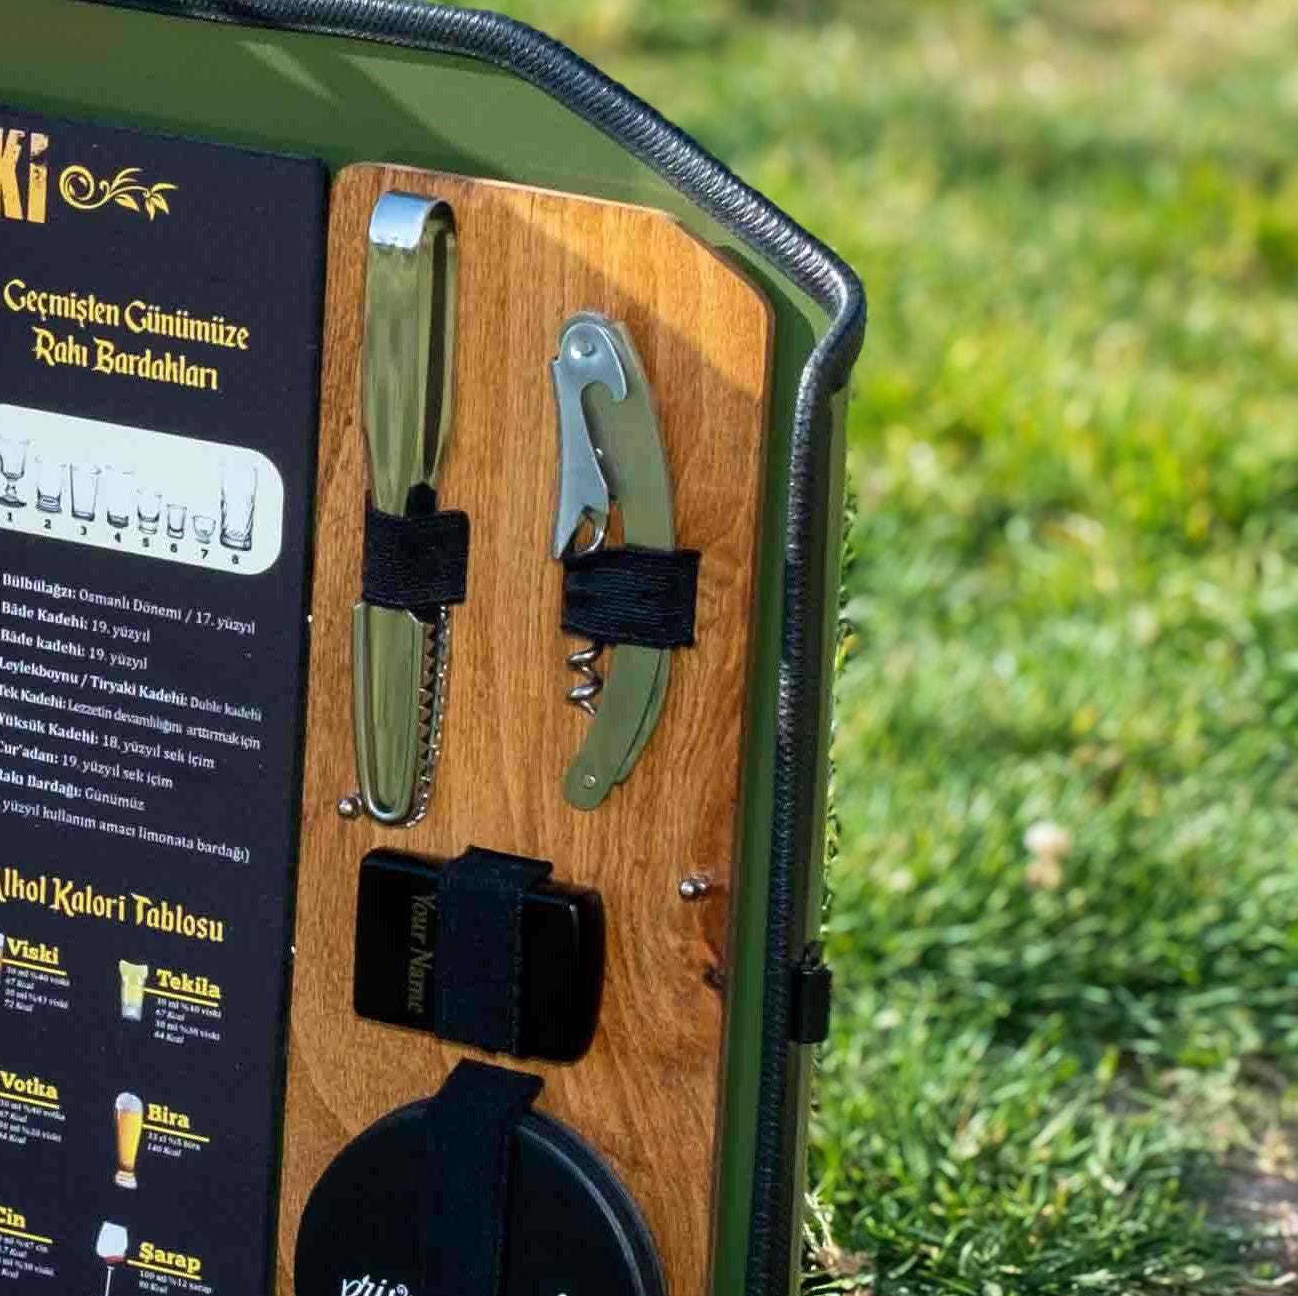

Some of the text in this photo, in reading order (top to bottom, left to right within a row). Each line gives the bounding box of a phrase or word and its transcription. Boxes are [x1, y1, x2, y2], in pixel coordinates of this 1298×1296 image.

[2, 278, 250, 351] Geçmişten Günümüze
[31, 326, 221, 393] Rakı Bardakları
[78, 587, 131, 611] Osmanlı
[91, 618, 111, 635] 19.
[88, 646, 108, 663] 19.
[59, 753, 81, 770] 19.
[138, 825, 195, 850] limonata
[48, 876, 127, 922] Kalori
[130, 892, 224, 943] Tablosu
[3, 935, 60, 966] Viski
[155, 968, 222, 1000] Tekila
[0, 1070, 59, 1101] Votka
[146, 1102, 191, 1130] Bira
[137, 1241, 202, 1278] Şarap
